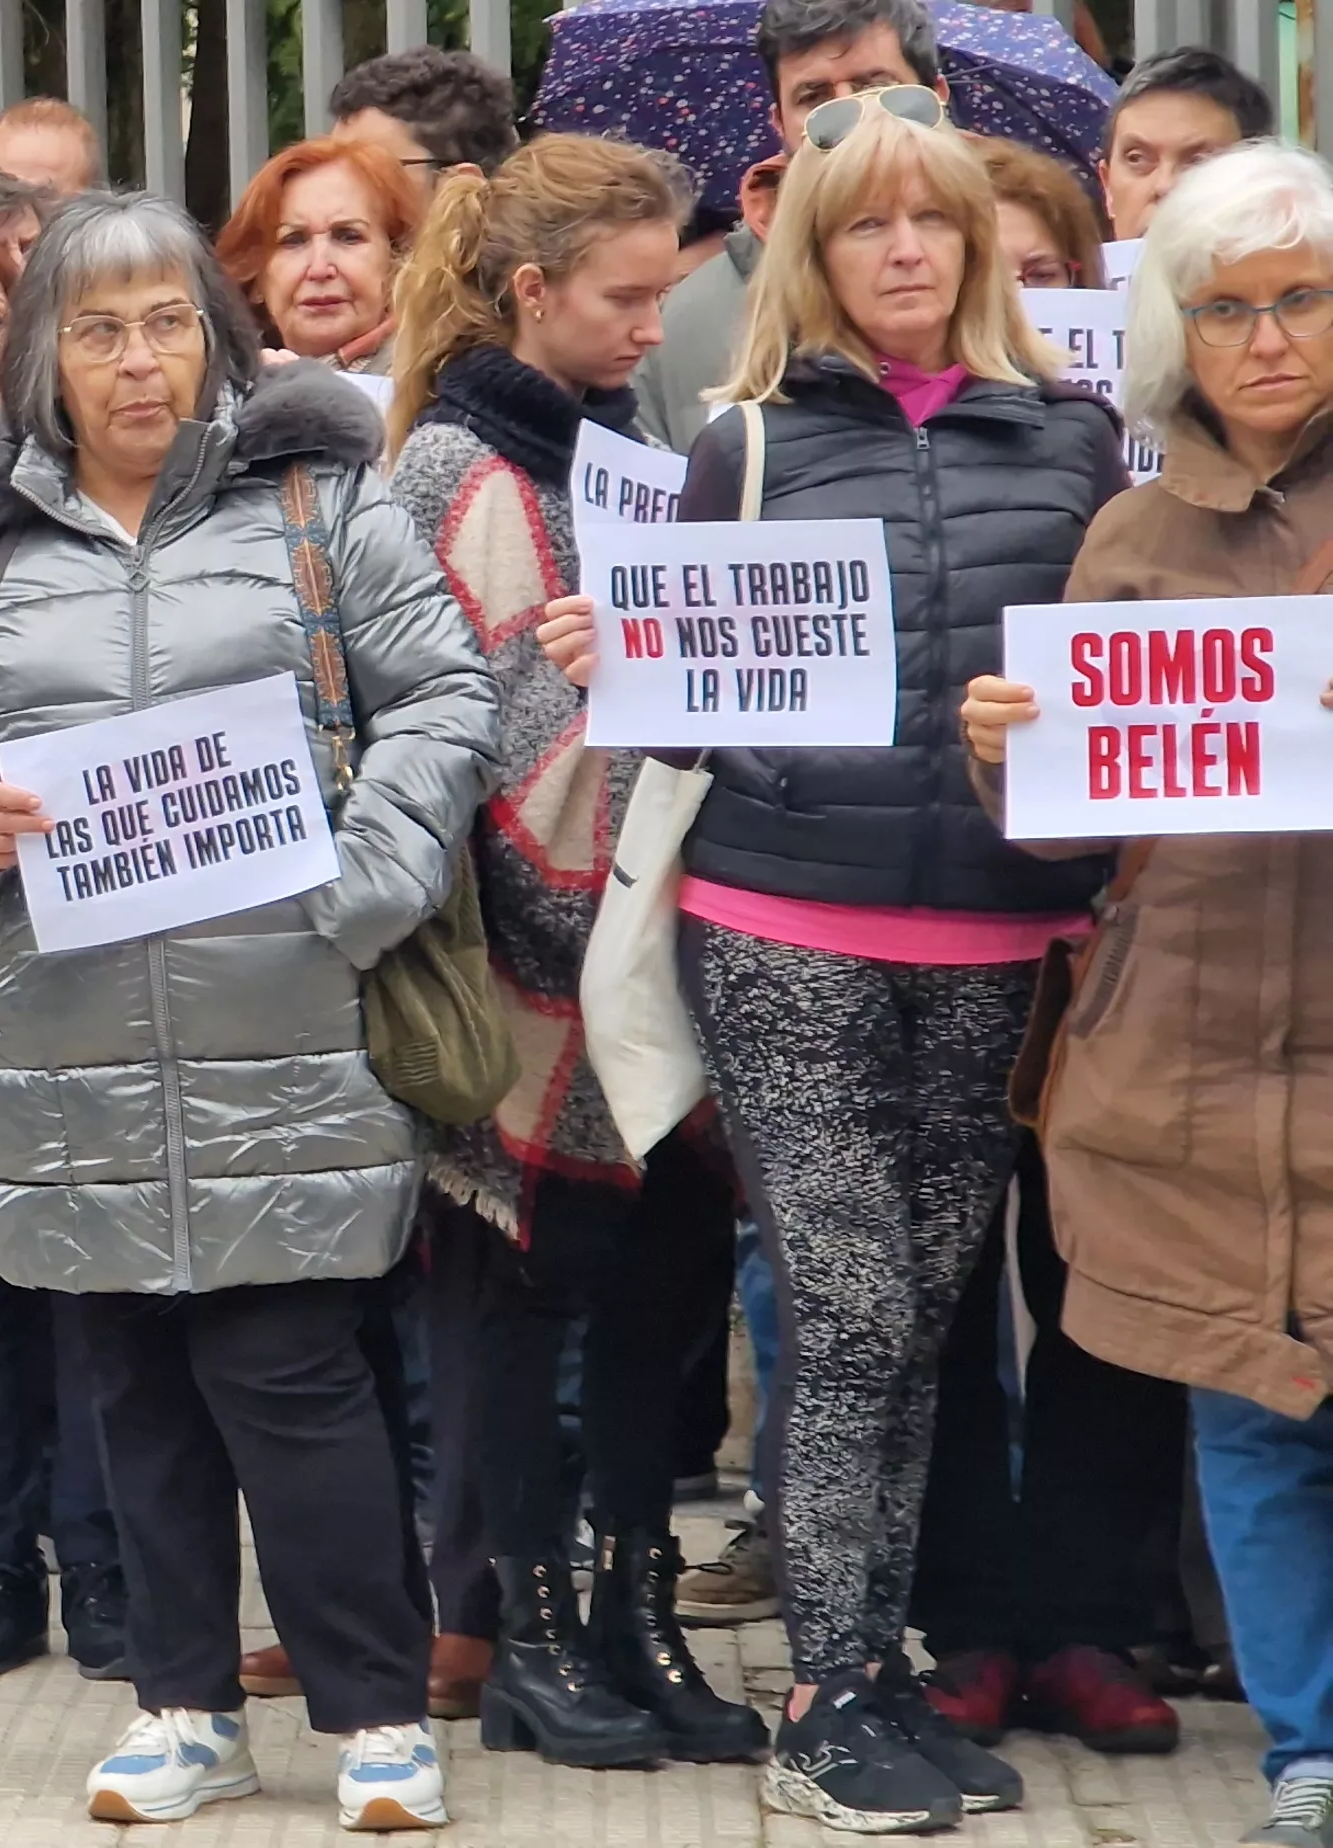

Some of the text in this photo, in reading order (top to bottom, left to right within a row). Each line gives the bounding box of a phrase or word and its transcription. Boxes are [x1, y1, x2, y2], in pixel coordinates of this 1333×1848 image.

[584, 462, 609, 509] LA
[610, 559, 870, 611] QUE EL TRABAJO
[621, 613, 870, 659] NO NOS CUESTE
[1071, 627, 1275, 707] SOMOS
[686, 667, 808, 713] LA VIDA
[83, 731, 232, 806] LA VIDA DE
[1088, 708, 1261, 800] BELÉN
[44, 758, 302, 860] LAS QUE CUIDAMOS
[56, 804, 308, 902] TAMBIÉN IMPORTA
